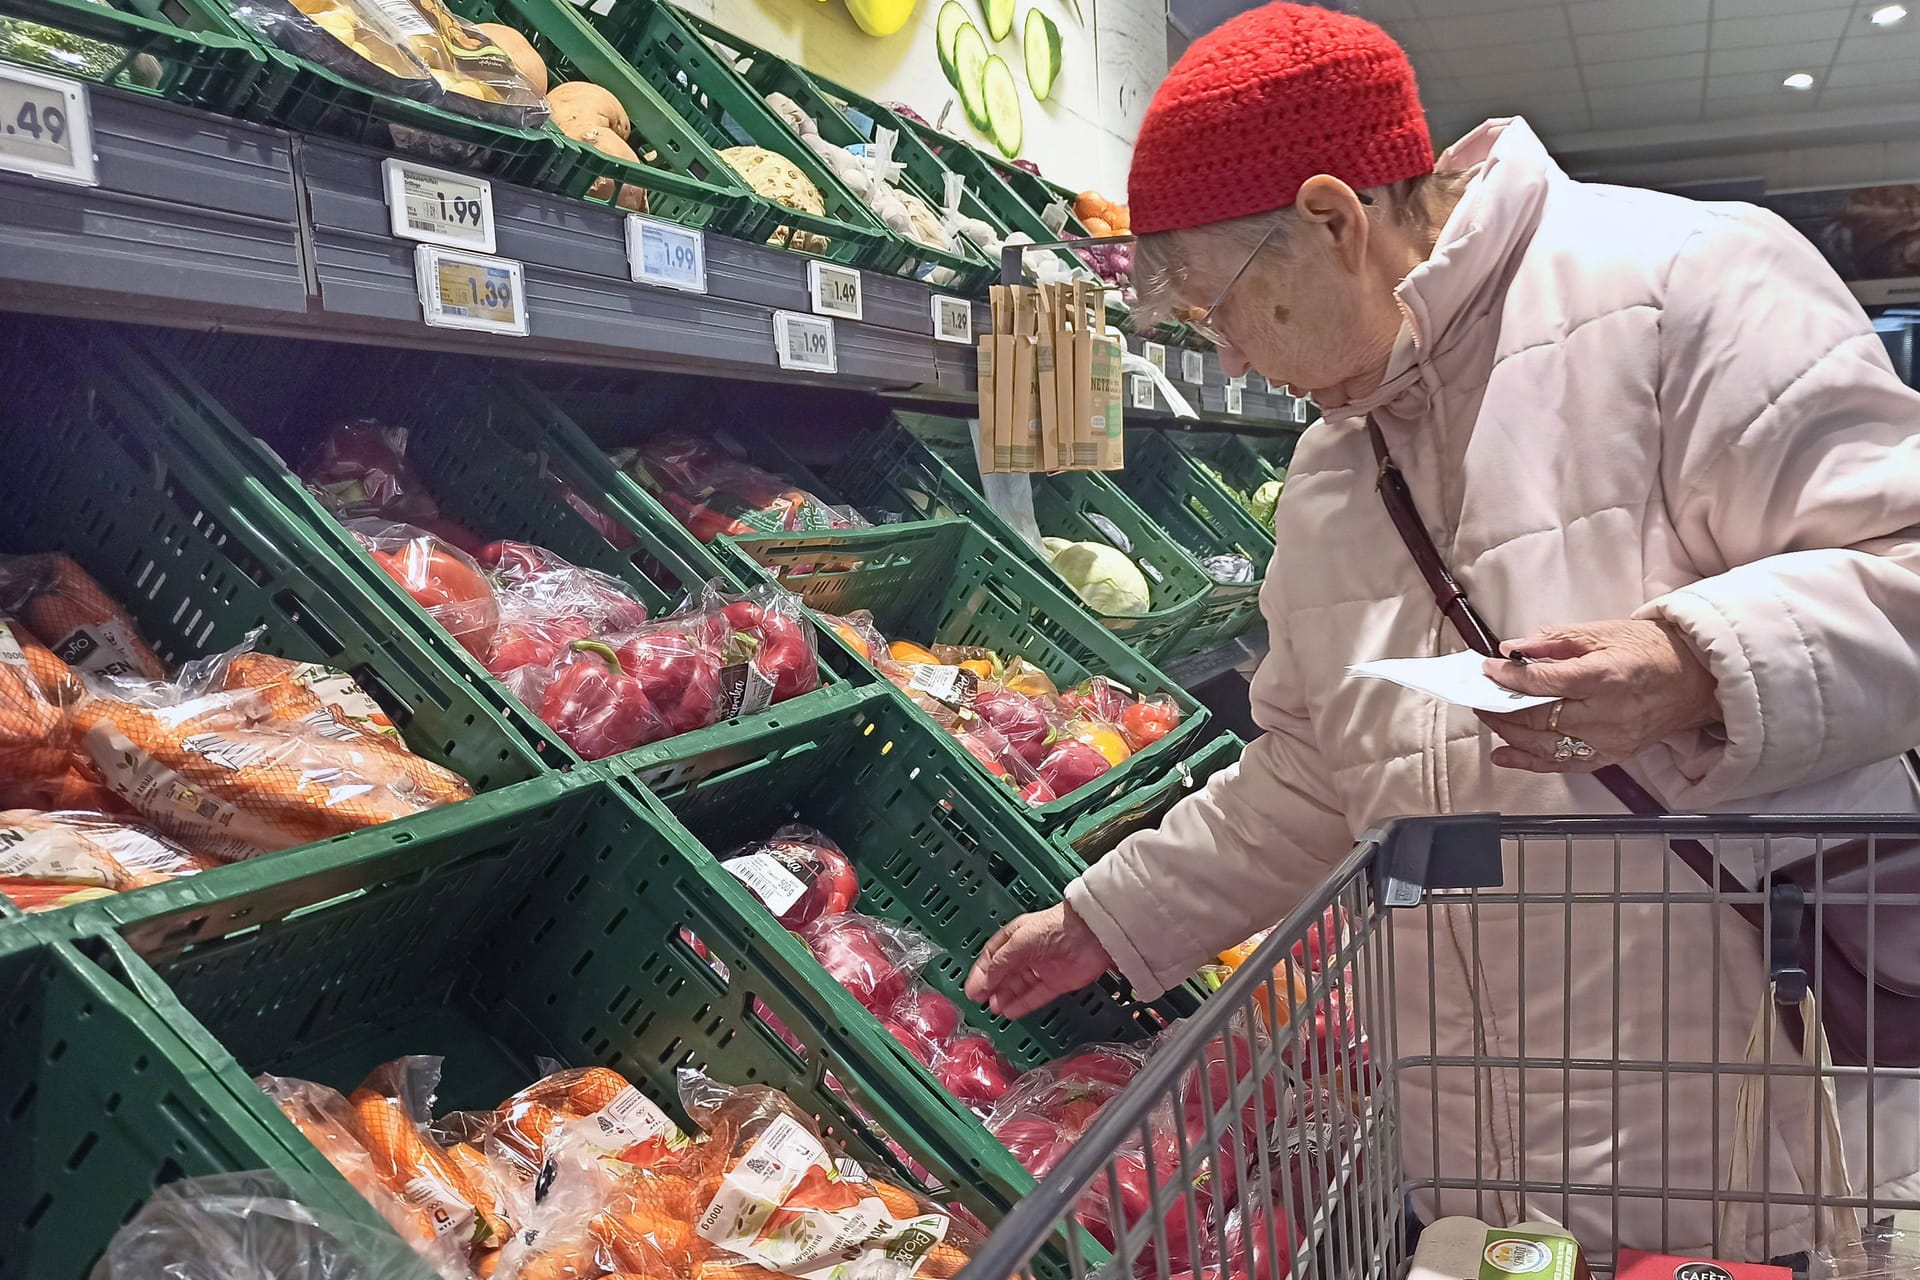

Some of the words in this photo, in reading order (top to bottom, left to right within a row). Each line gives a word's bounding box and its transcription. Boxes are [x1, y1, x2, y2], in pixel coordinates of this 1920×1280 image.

[0, 101, 65, 144] .49
[437, 192, 480, 226] 1.99
[664, 242, 694, 270] 1.99
[468, 277, 511, 309] 1.39
[834, 281, 856, 303] 1.49
[951, 311, 967, 330] 1.29
[803, 332, 827, 354] 1.99
